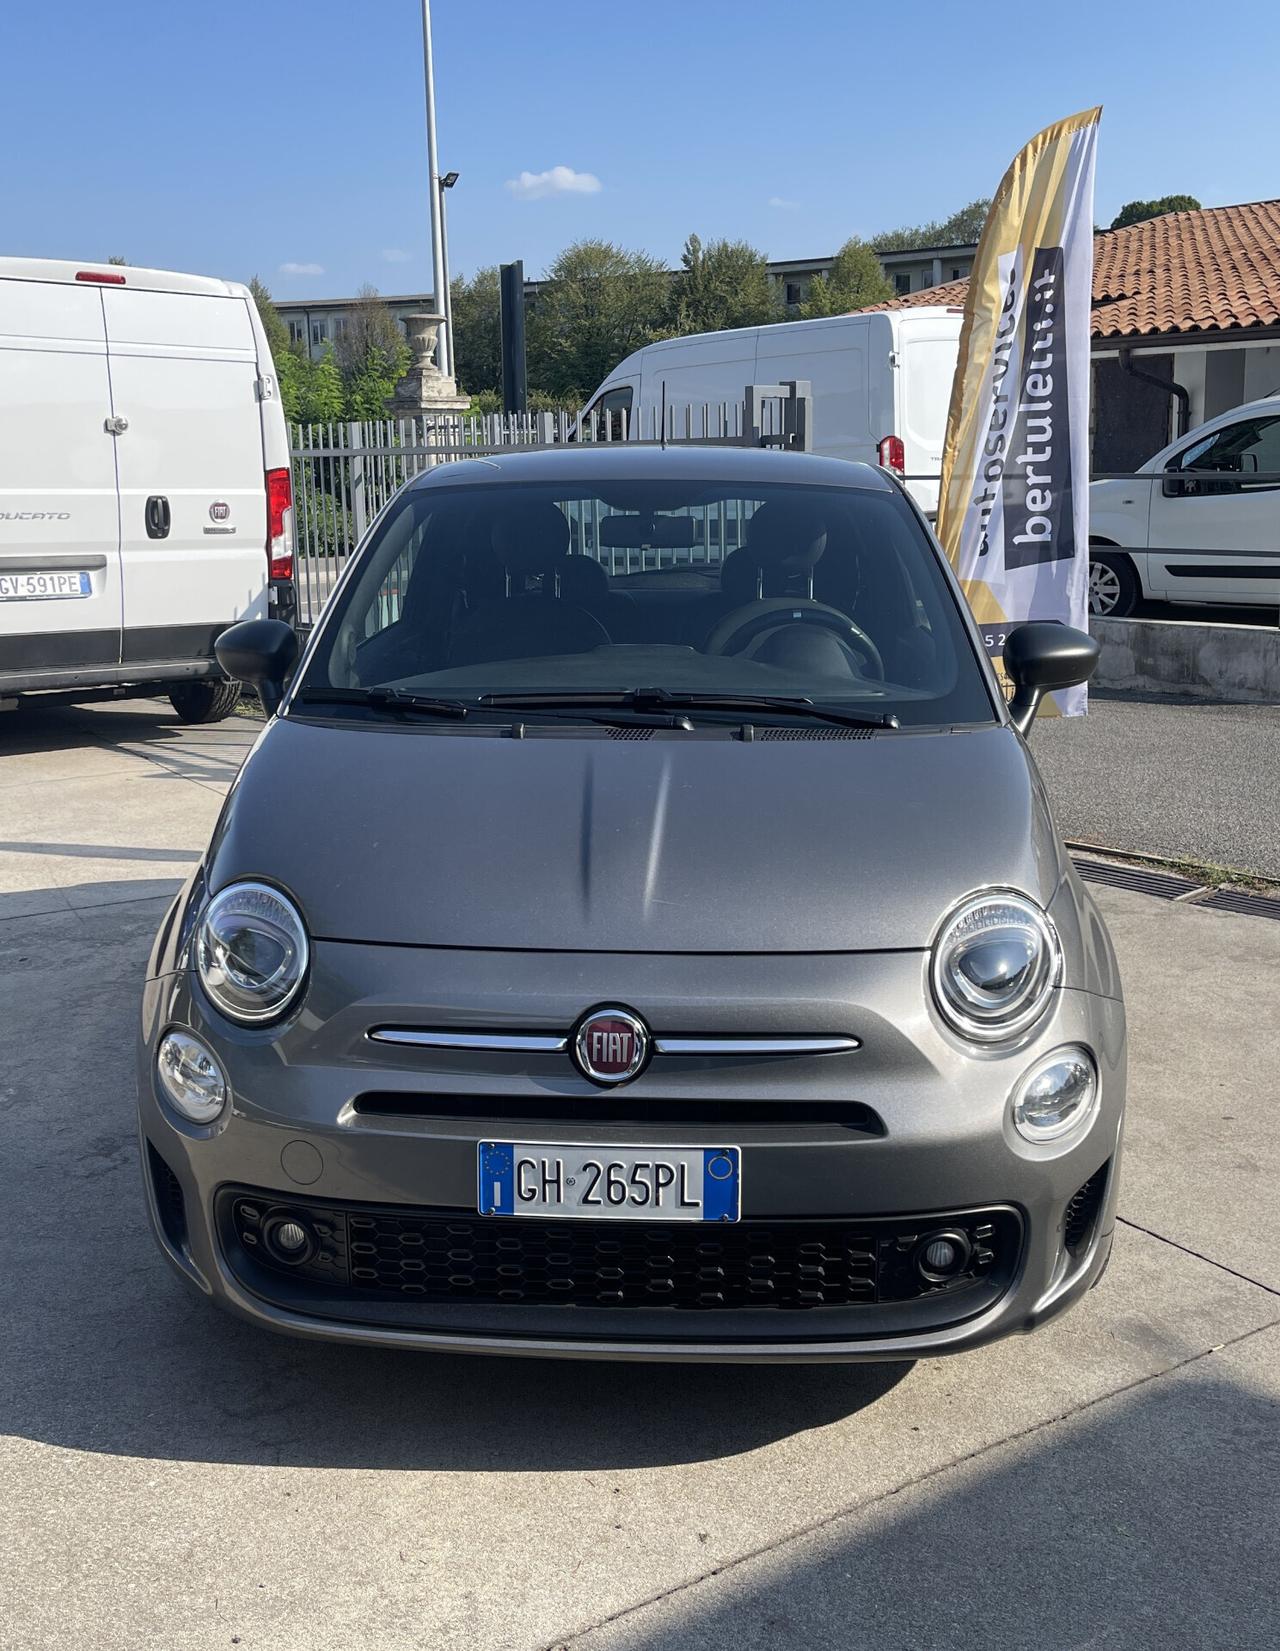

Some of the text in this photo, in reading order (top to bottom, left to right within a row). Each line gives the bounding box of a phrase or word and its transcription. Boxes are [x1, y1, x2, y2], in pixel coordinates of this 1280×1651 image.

[1012, 268, 1056, 545] bertuletti.it
[214, 506, 226, 517] FIAT
[26, 576, 79, 594] 591PE
[592, 1031, 632, 1063] FIAT
[581, 1160, 702, 1208] 265PL
